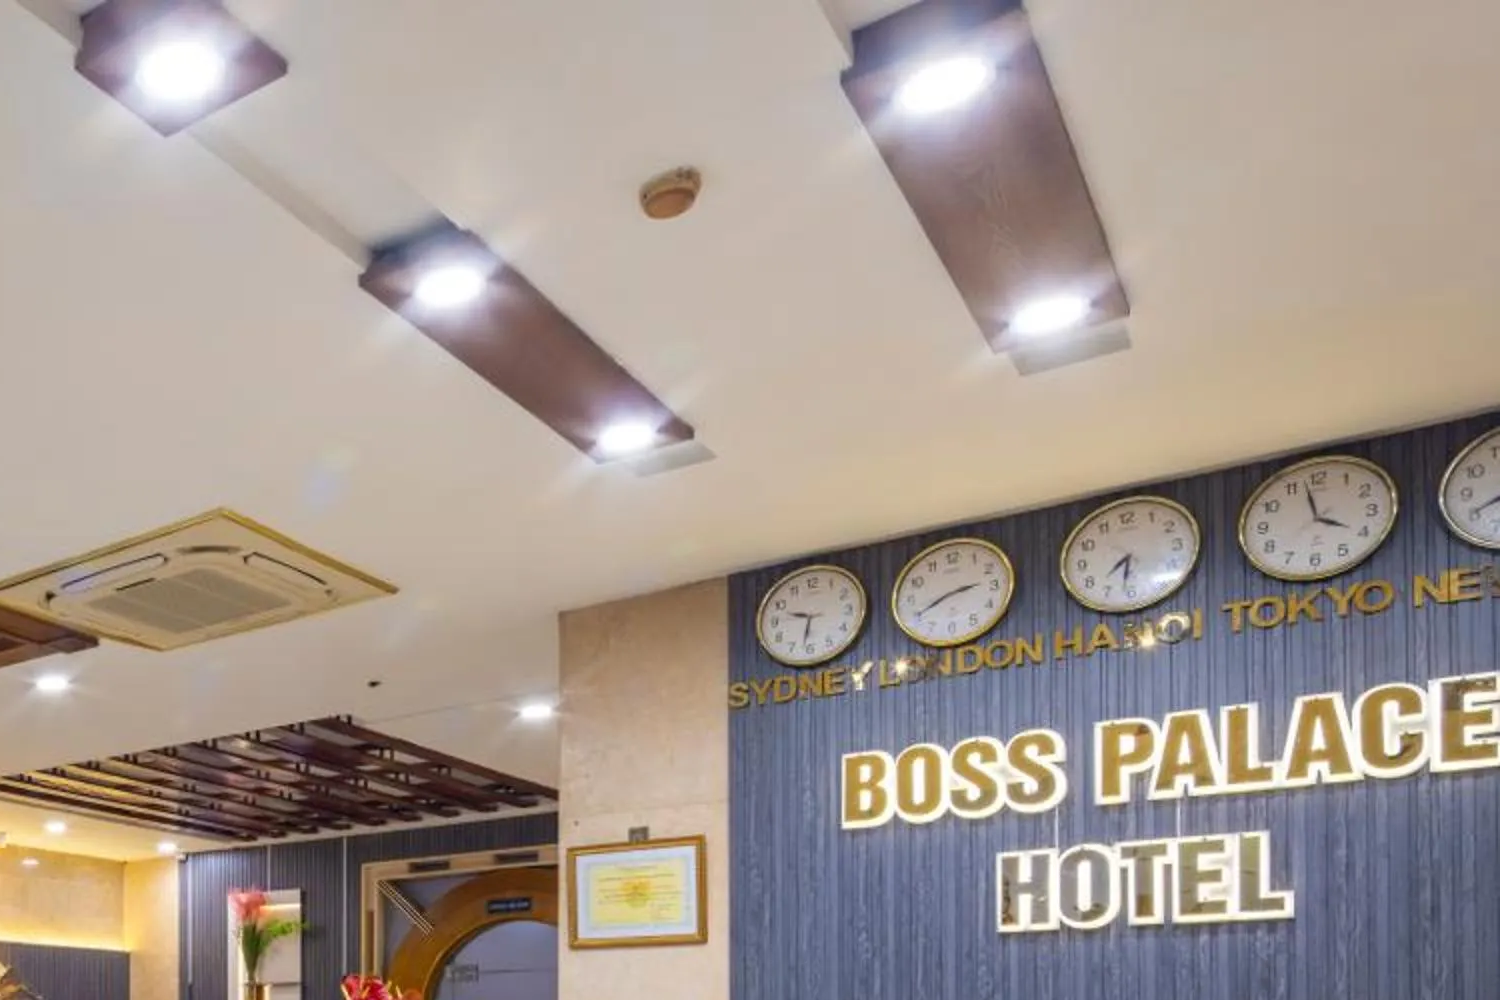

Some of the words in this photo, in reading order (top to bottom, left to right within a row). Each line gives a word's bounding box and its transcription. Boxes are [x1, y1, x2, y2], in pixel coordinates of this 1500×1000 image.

[1310, 471, 1327, 485] 12
[1285, 482, 1297, 495] 11
[1358, 483, 1371, 498] 2
[1264, 500, 1279, 513] 10
[1365, 503, 1378, 517] 3
[1257, 521, 1269, 535] 9
[1357, 525, 1368, 537] 4
[1264, 540, 1275, 553] 8
[1337, 544, 1349, 556] 5
[1284, 551, 1295, 564] 7
[1309, 552, 1321, 566] 6
[728, 661, 873, 709] SYDNEY
[879, 633, 1043, 688] LONDON
[1053, 608, 1203, 660] HANOI
[1220, 579, 1394, 633] TOKYO
[841, 729, 1067, 829] BOSS
[1095, 672, 1500, 805] PALACE
[995, 831, 1295, 932] HOTEL
